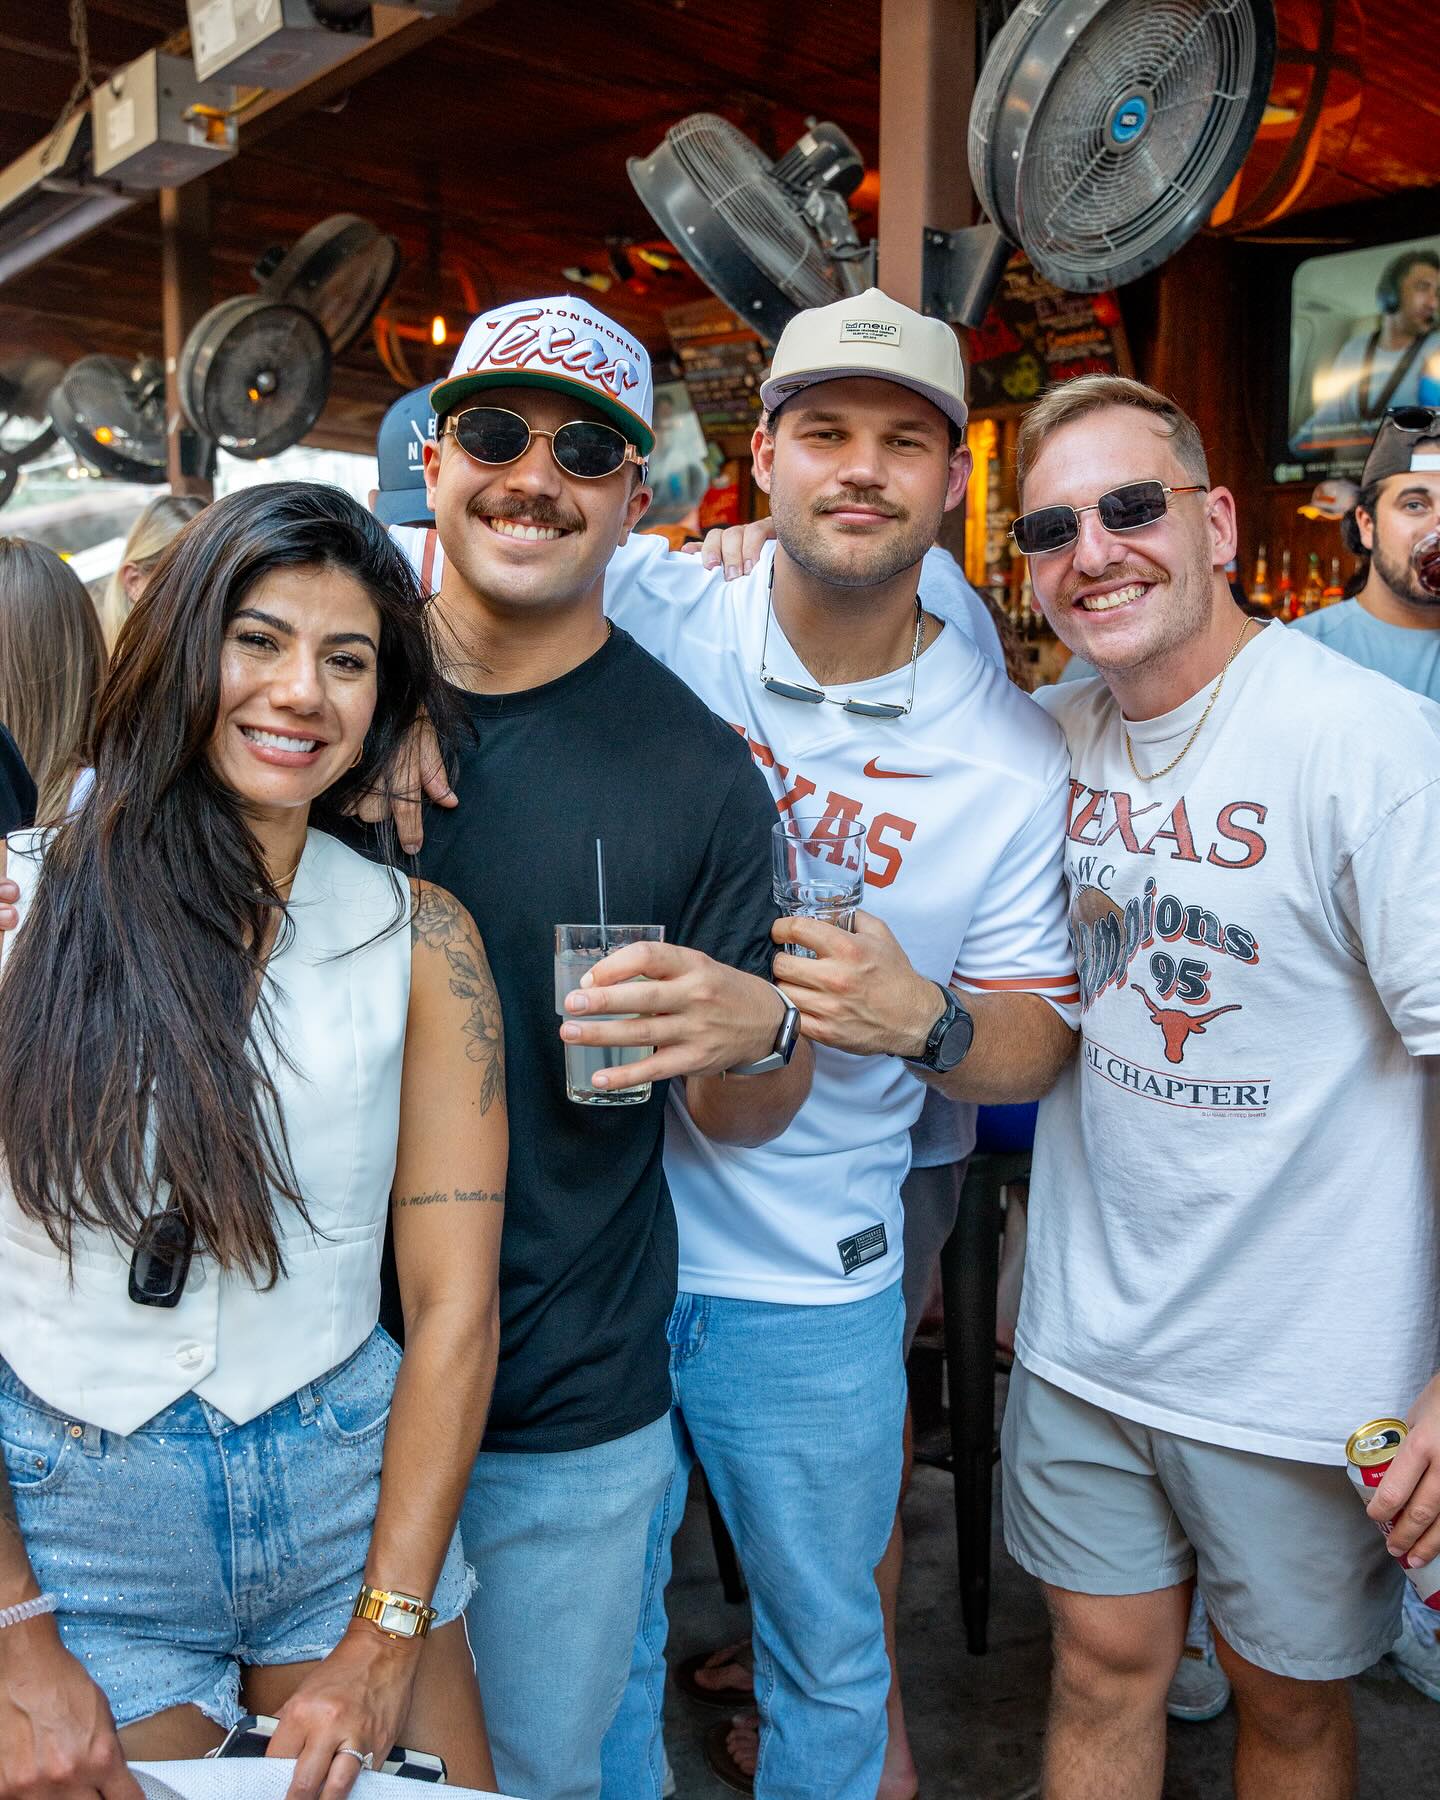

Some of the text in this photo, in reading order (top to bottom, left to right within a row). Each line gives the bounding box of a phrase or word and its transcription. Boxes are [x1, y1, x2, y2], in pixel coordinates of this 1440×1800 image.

[546, 308, 641, 362] LONGHORNS
[858, 322, 897, 332] melin
[467, 308, 639, 400] Texas
[408, 441, 418, 460] N
[1149, 951, 1212, 1005] 95
[1107, 1058, 1271, 1105] CHAPTER!
